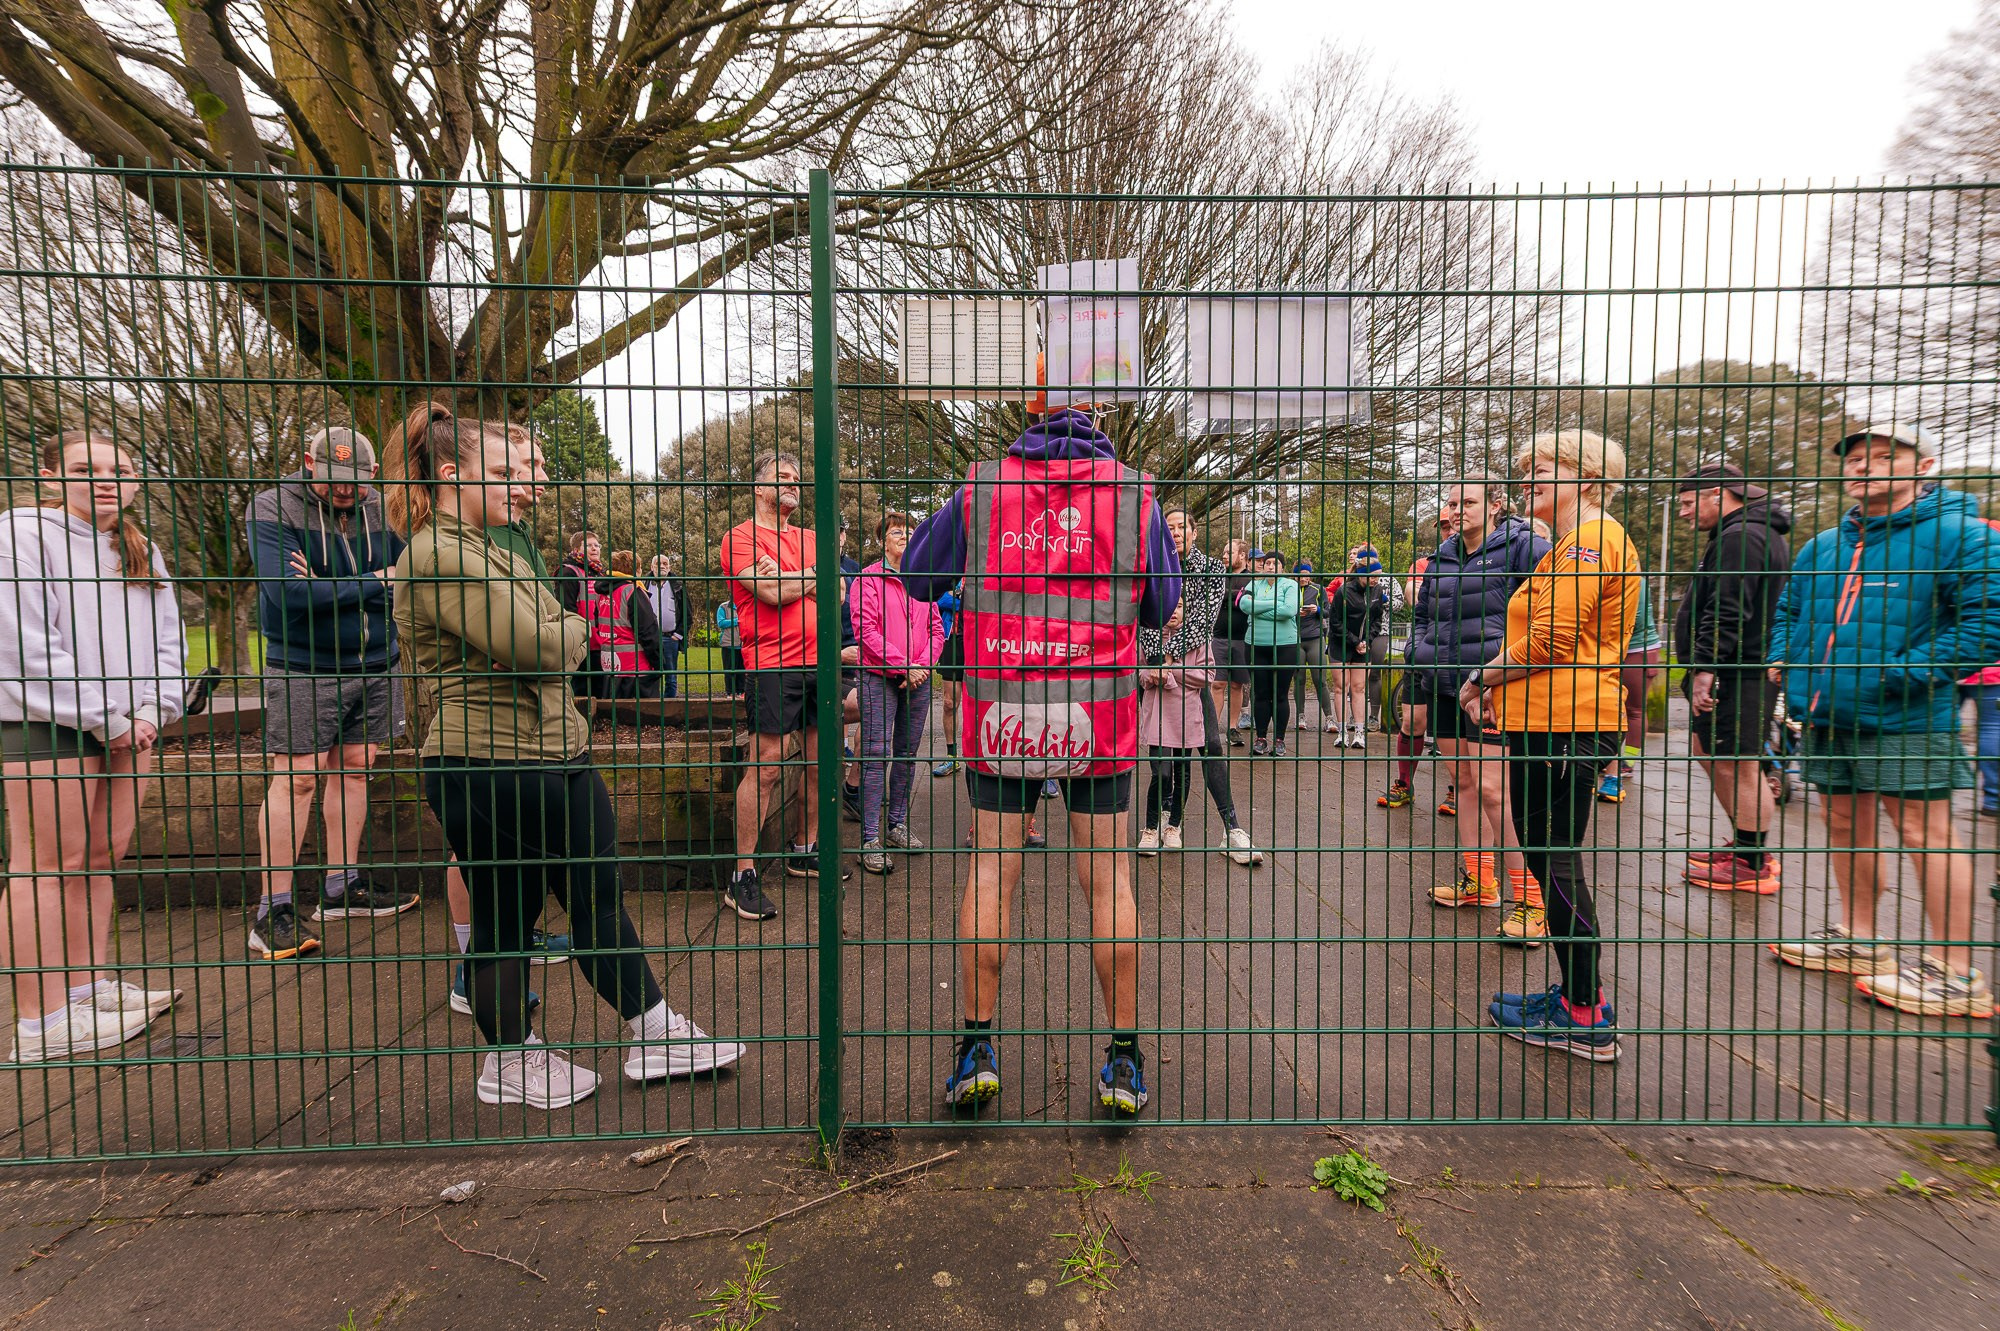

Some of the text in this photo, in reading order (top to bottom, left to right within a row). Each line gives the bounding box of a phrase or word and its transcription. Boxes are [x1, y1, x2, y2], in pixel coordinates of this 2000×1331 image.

[1000, 528, 1094, 554] parkrun
[985, 638, 1091, 657] VOLUNTEER
[985, 714, 1091, 770] Vitality
